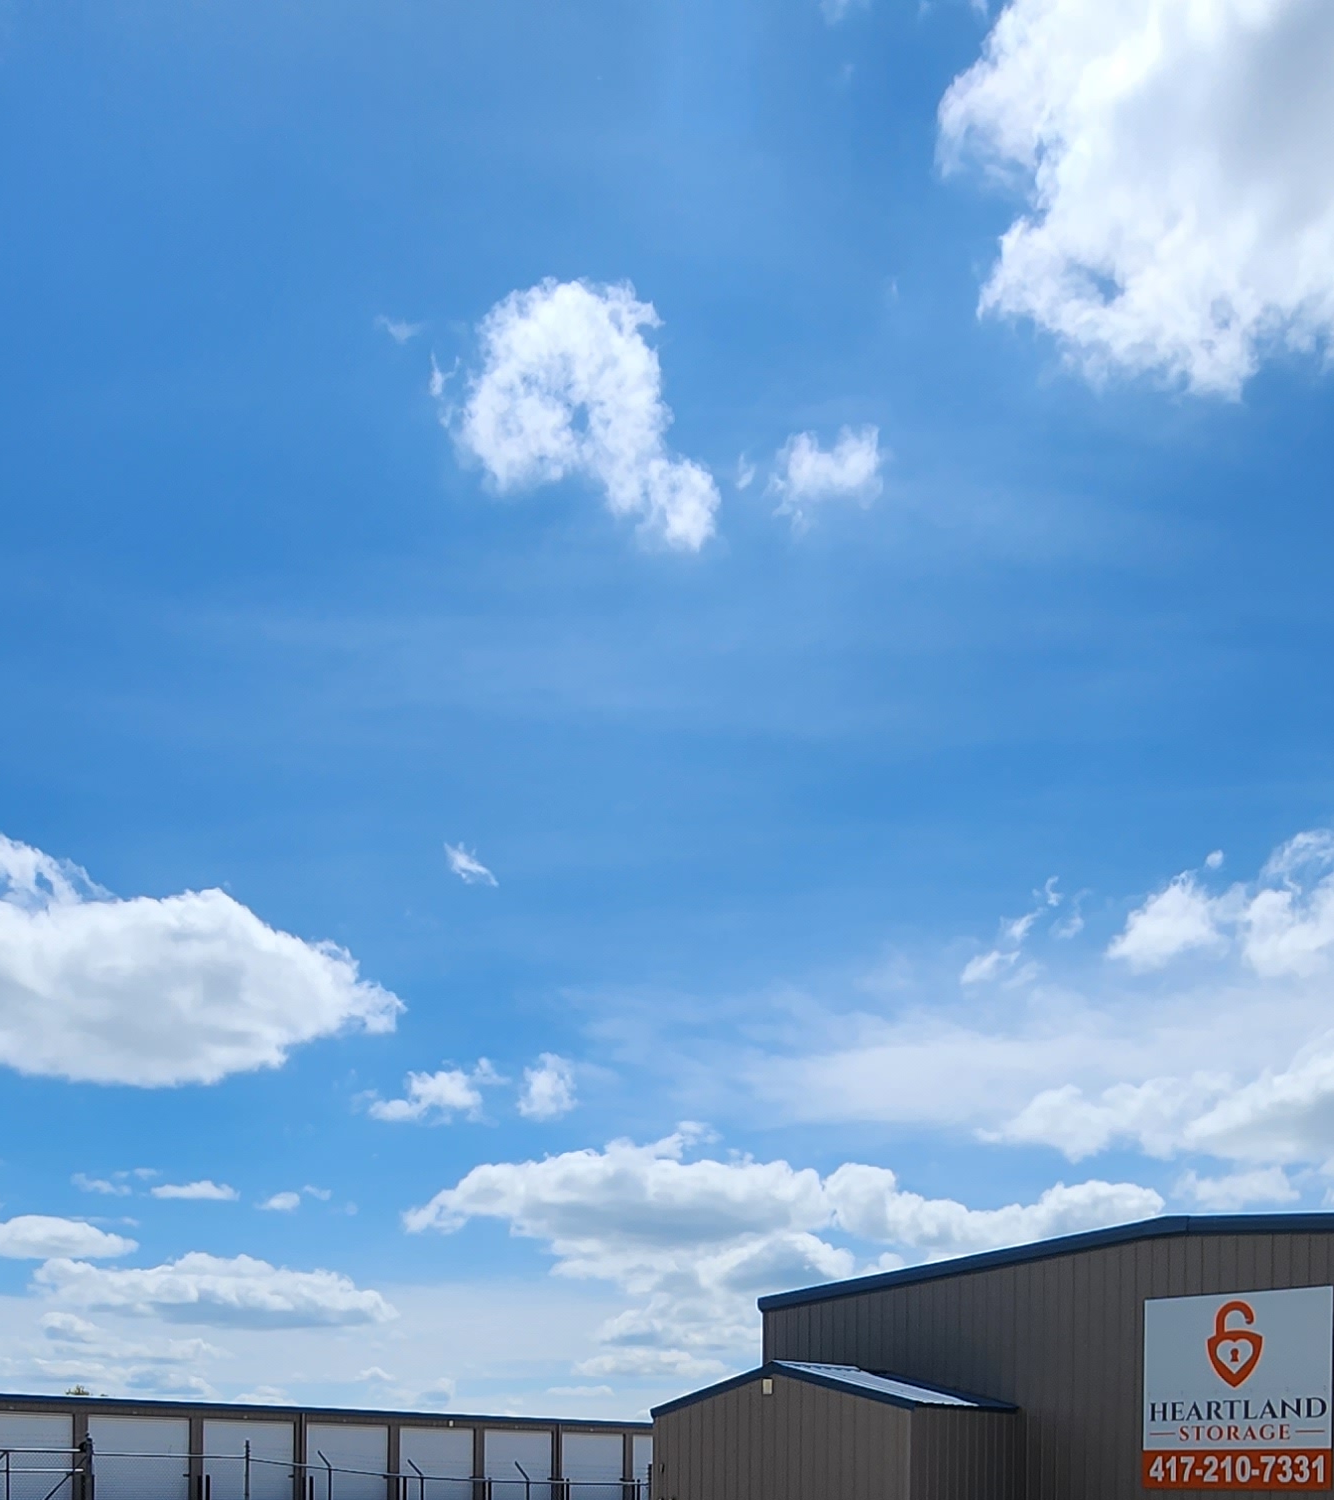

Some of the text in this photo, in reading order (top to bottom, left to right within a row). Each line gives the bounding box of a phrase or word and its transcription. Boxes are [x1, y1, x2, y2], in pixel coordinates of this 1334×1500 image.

[1149, 1397, 1327, 1422] HEARTLAND
[1179, 1424, 1291, 1441] STORAGE
[1149, 1455, 1325, 1483] 417-210-7331
